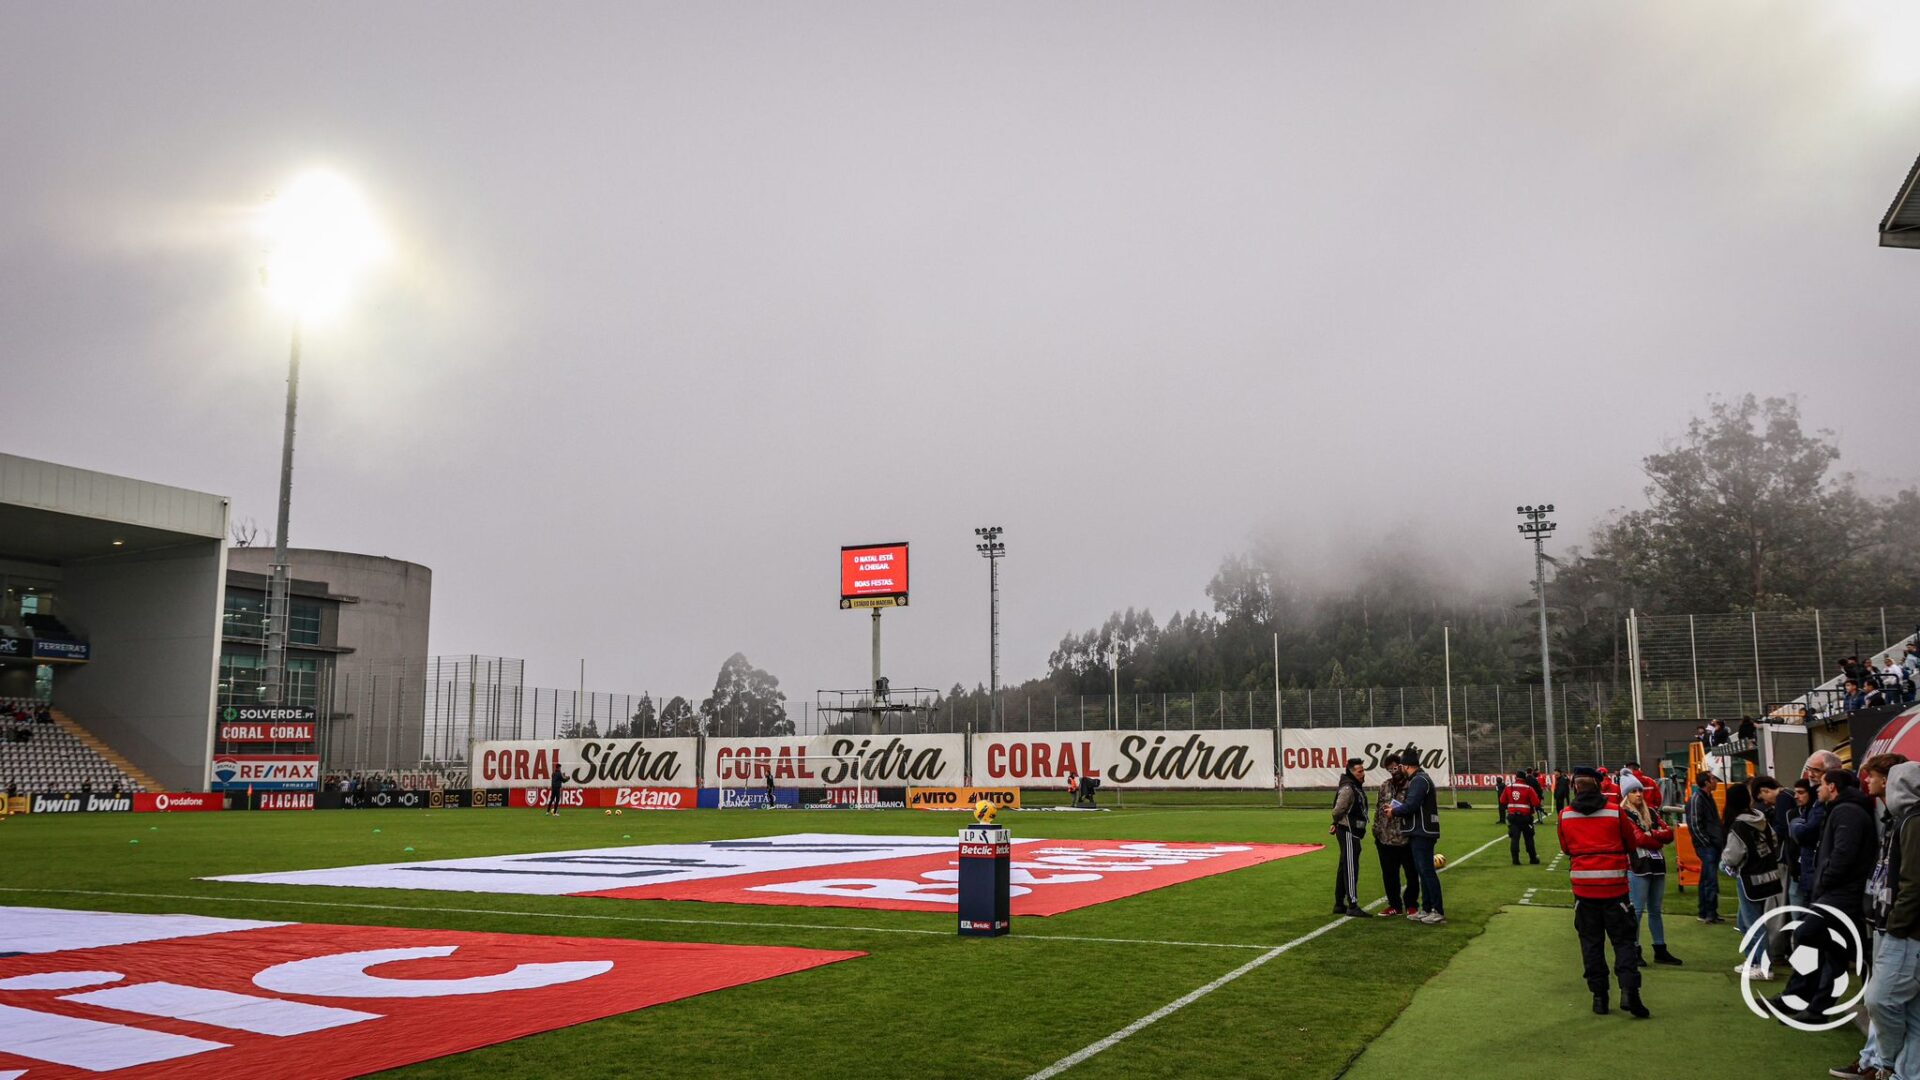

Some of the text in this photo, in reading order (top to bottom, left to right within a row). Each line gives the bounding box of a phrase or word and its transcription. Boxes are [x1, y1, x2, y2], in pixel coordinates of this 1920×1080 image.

[860, 555, 878, 563] NATAL
[879, 552, 893, 561] ESTÁ
[240, 709, 314, 719] SOLVERDE.PT
[222, 726, 311, 739] CORAL CORAL
[483, 741, 682, 785] CORAL Sidra
[716, 737, 947, 785] CORAL Sidra
[987, 734, 1254, 784] CORAL Sidra
[240, 764, 314, 779] RE/MAX
[402, 774, 440, 789] CORAL
[33, 793, 80, 812] bwin
[86, 793, 131, 812] bwin
[169, 797, 204, 806] vodafone
[260, 793, 315, 809] PLACARD
[371, 792, 391, 806] NOS
[398, 792, 419, 806] NOS
[444, 794, 460, 803] ESC
[487, 793, 502, 802] ESC
[540, 788, 584, 807] SARES
[616, 788, 681, 806] Betano
[923, 791, 957, 804] VITO
[979, 791, 1015, 804] VITO
[965, 831, 975, 842] LP
[961, 845, 992, 855] Betclic
